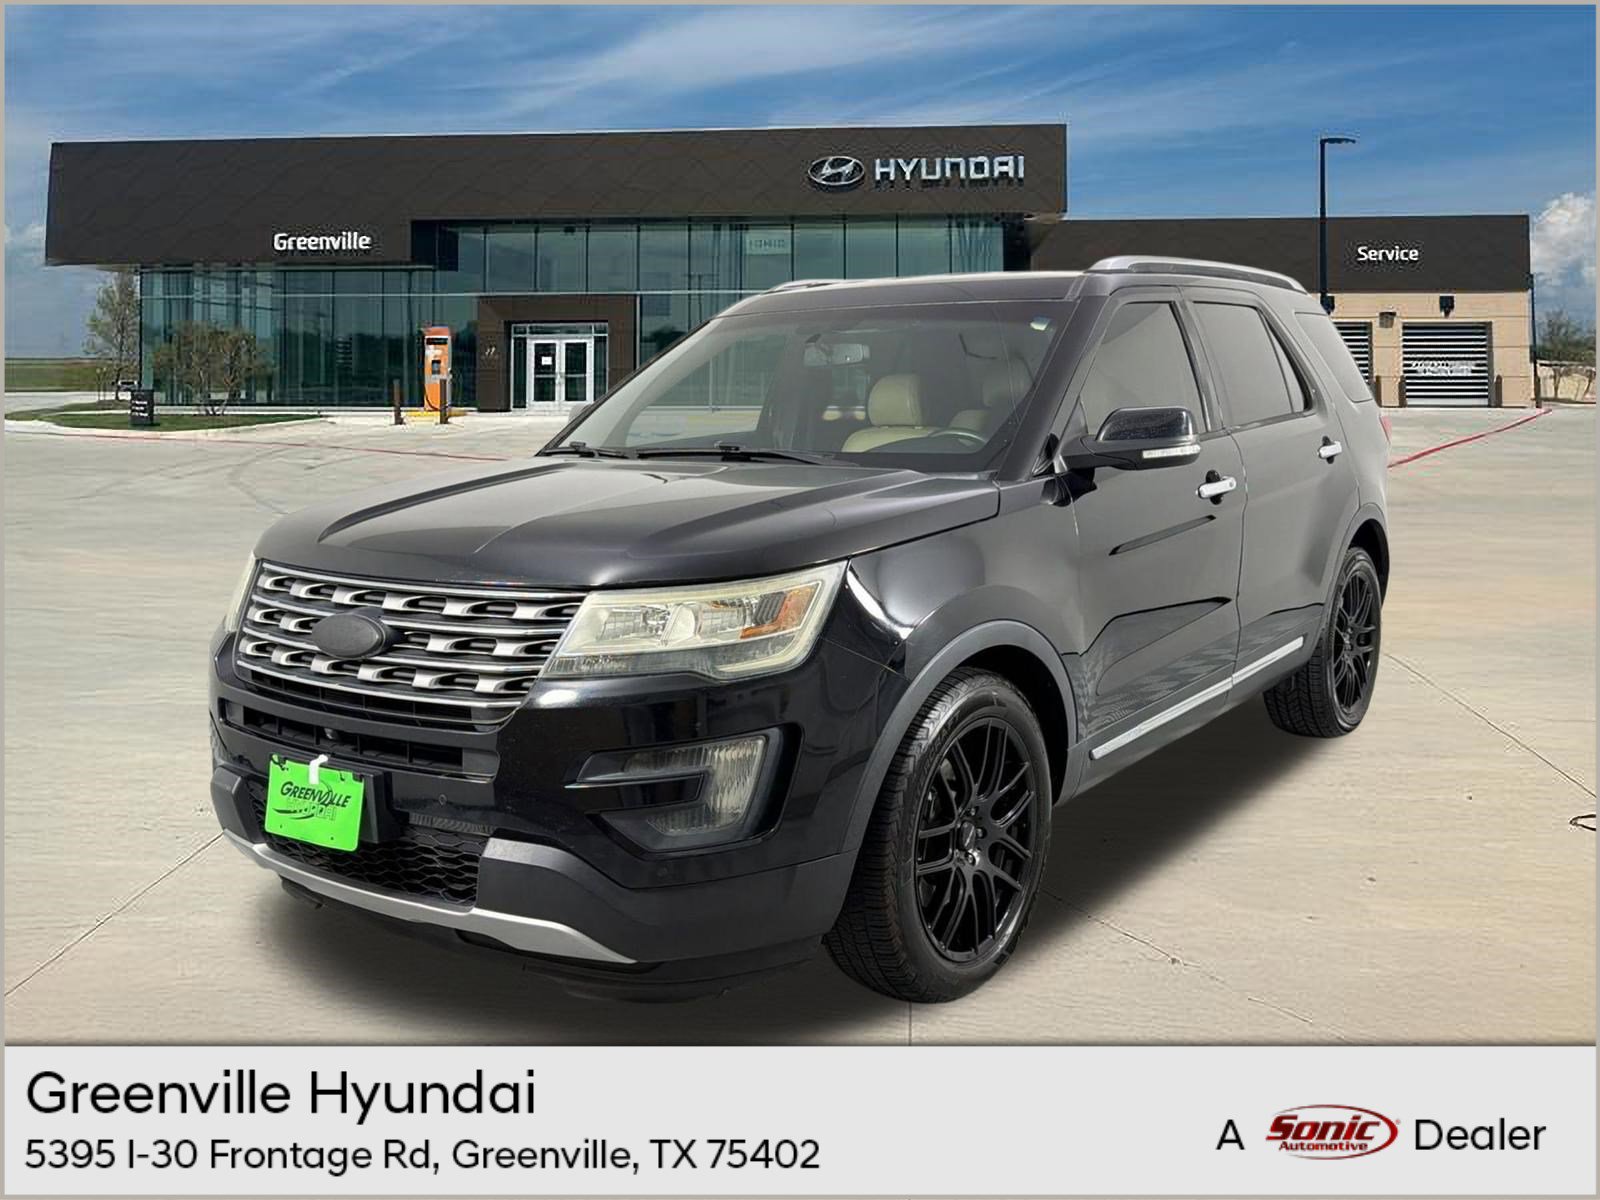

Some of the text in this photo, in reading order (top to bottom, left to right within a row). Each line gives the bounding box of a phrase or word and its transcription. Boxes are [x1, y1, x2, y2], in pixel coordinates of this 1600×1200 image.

[874, 155, 1025, 181] HYUNDAI
[272, 231, 372, 251] Greenville
[1356, 244, 1420, 262] Service
